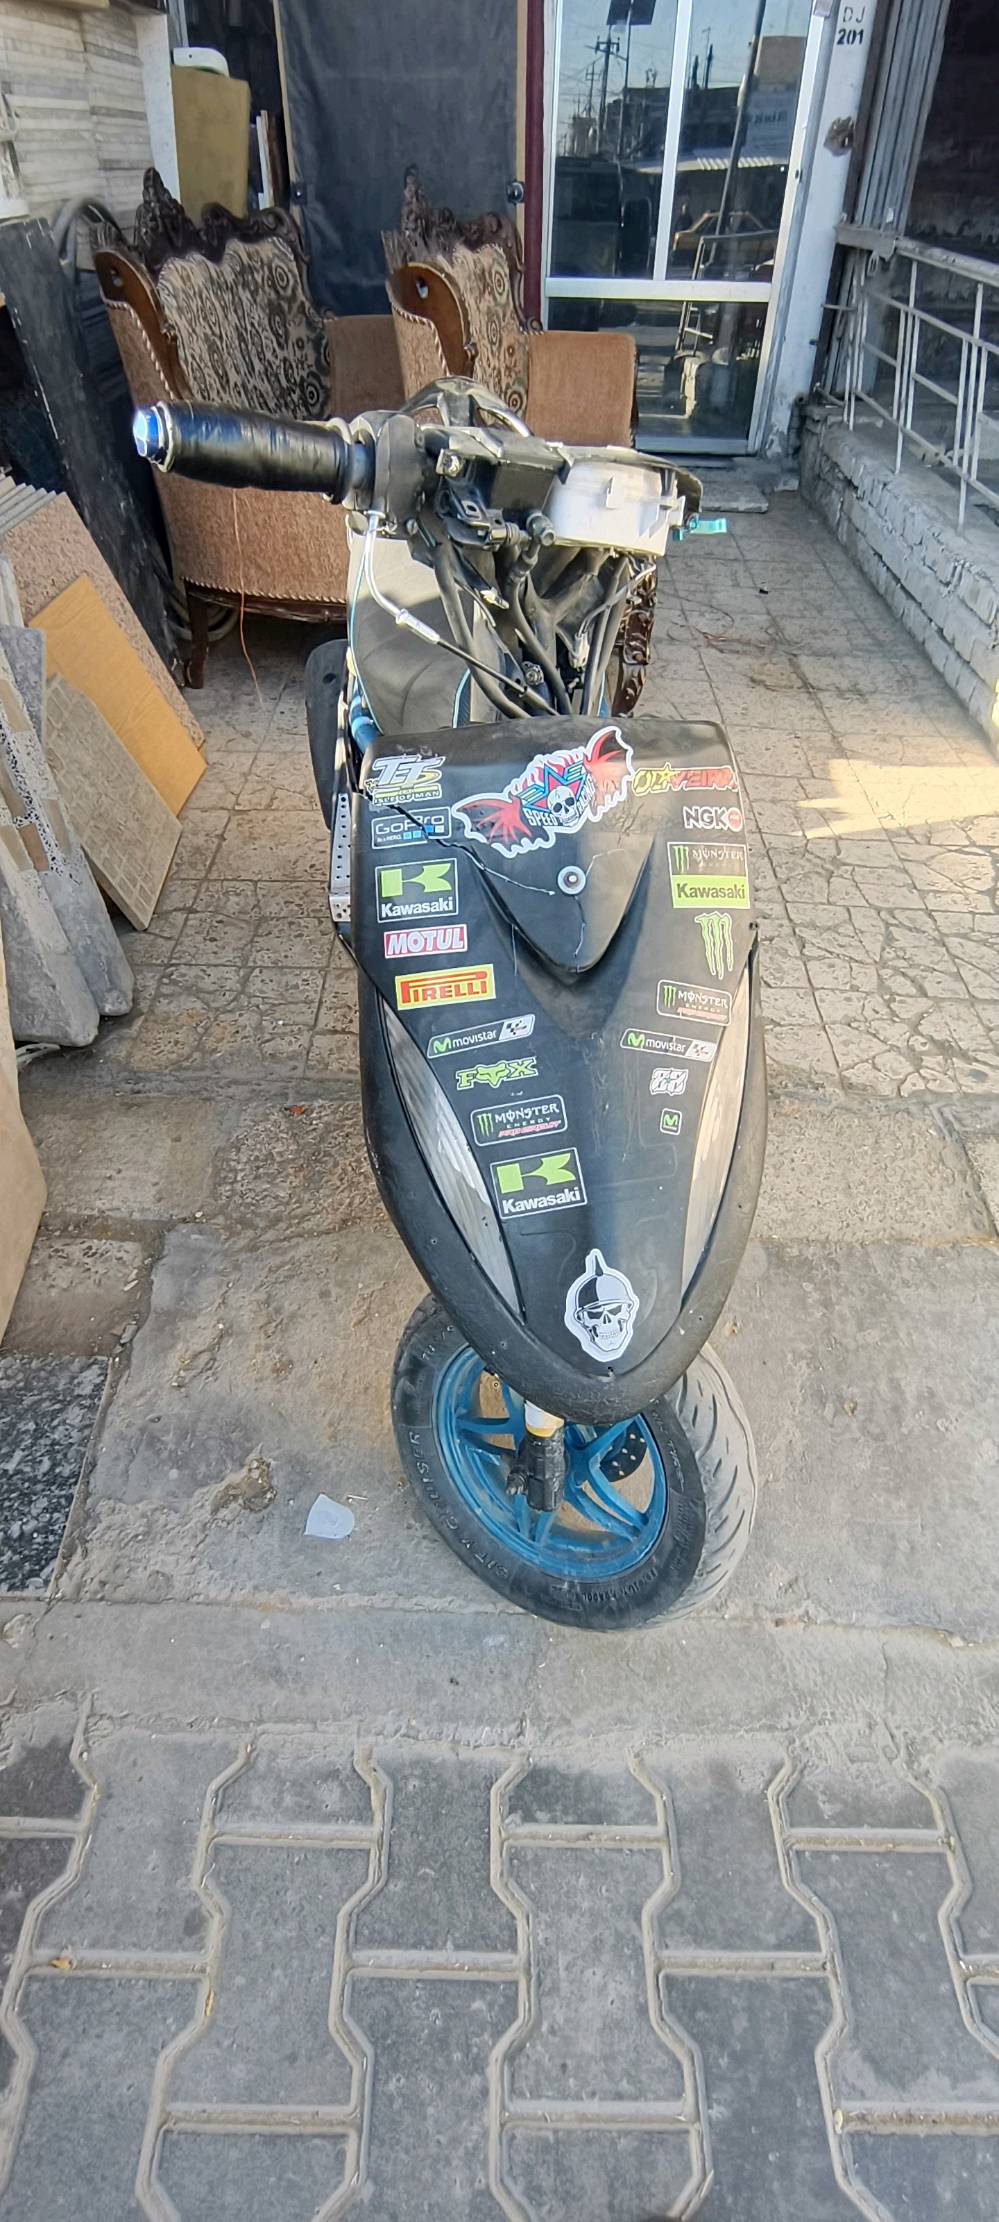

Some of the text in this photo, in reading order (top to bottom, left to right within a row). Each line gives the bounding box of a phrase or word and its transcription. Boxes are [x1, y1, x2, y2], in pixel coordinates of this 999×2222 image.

[837, 28, 864, 45] 201
[415, 790, 440, 800] MAN
[524, 808, 561, 828] SPEED
[684, 807, 730, 829] NGK
[676, 882, 746, 899] Kawasaki
[381, 896, 454, 918] Kawasaki
[387, 927, 465, 955] MOTUL
[401, 970, 488, 1004] PIRELLI
[453, 1029, 497, 1049] movistar
[646, 1036, 686, 1053] movistar
[495, 1103, 560, 1126] MONSTER
[502, 1187, 581, 1214] Kawasaki
